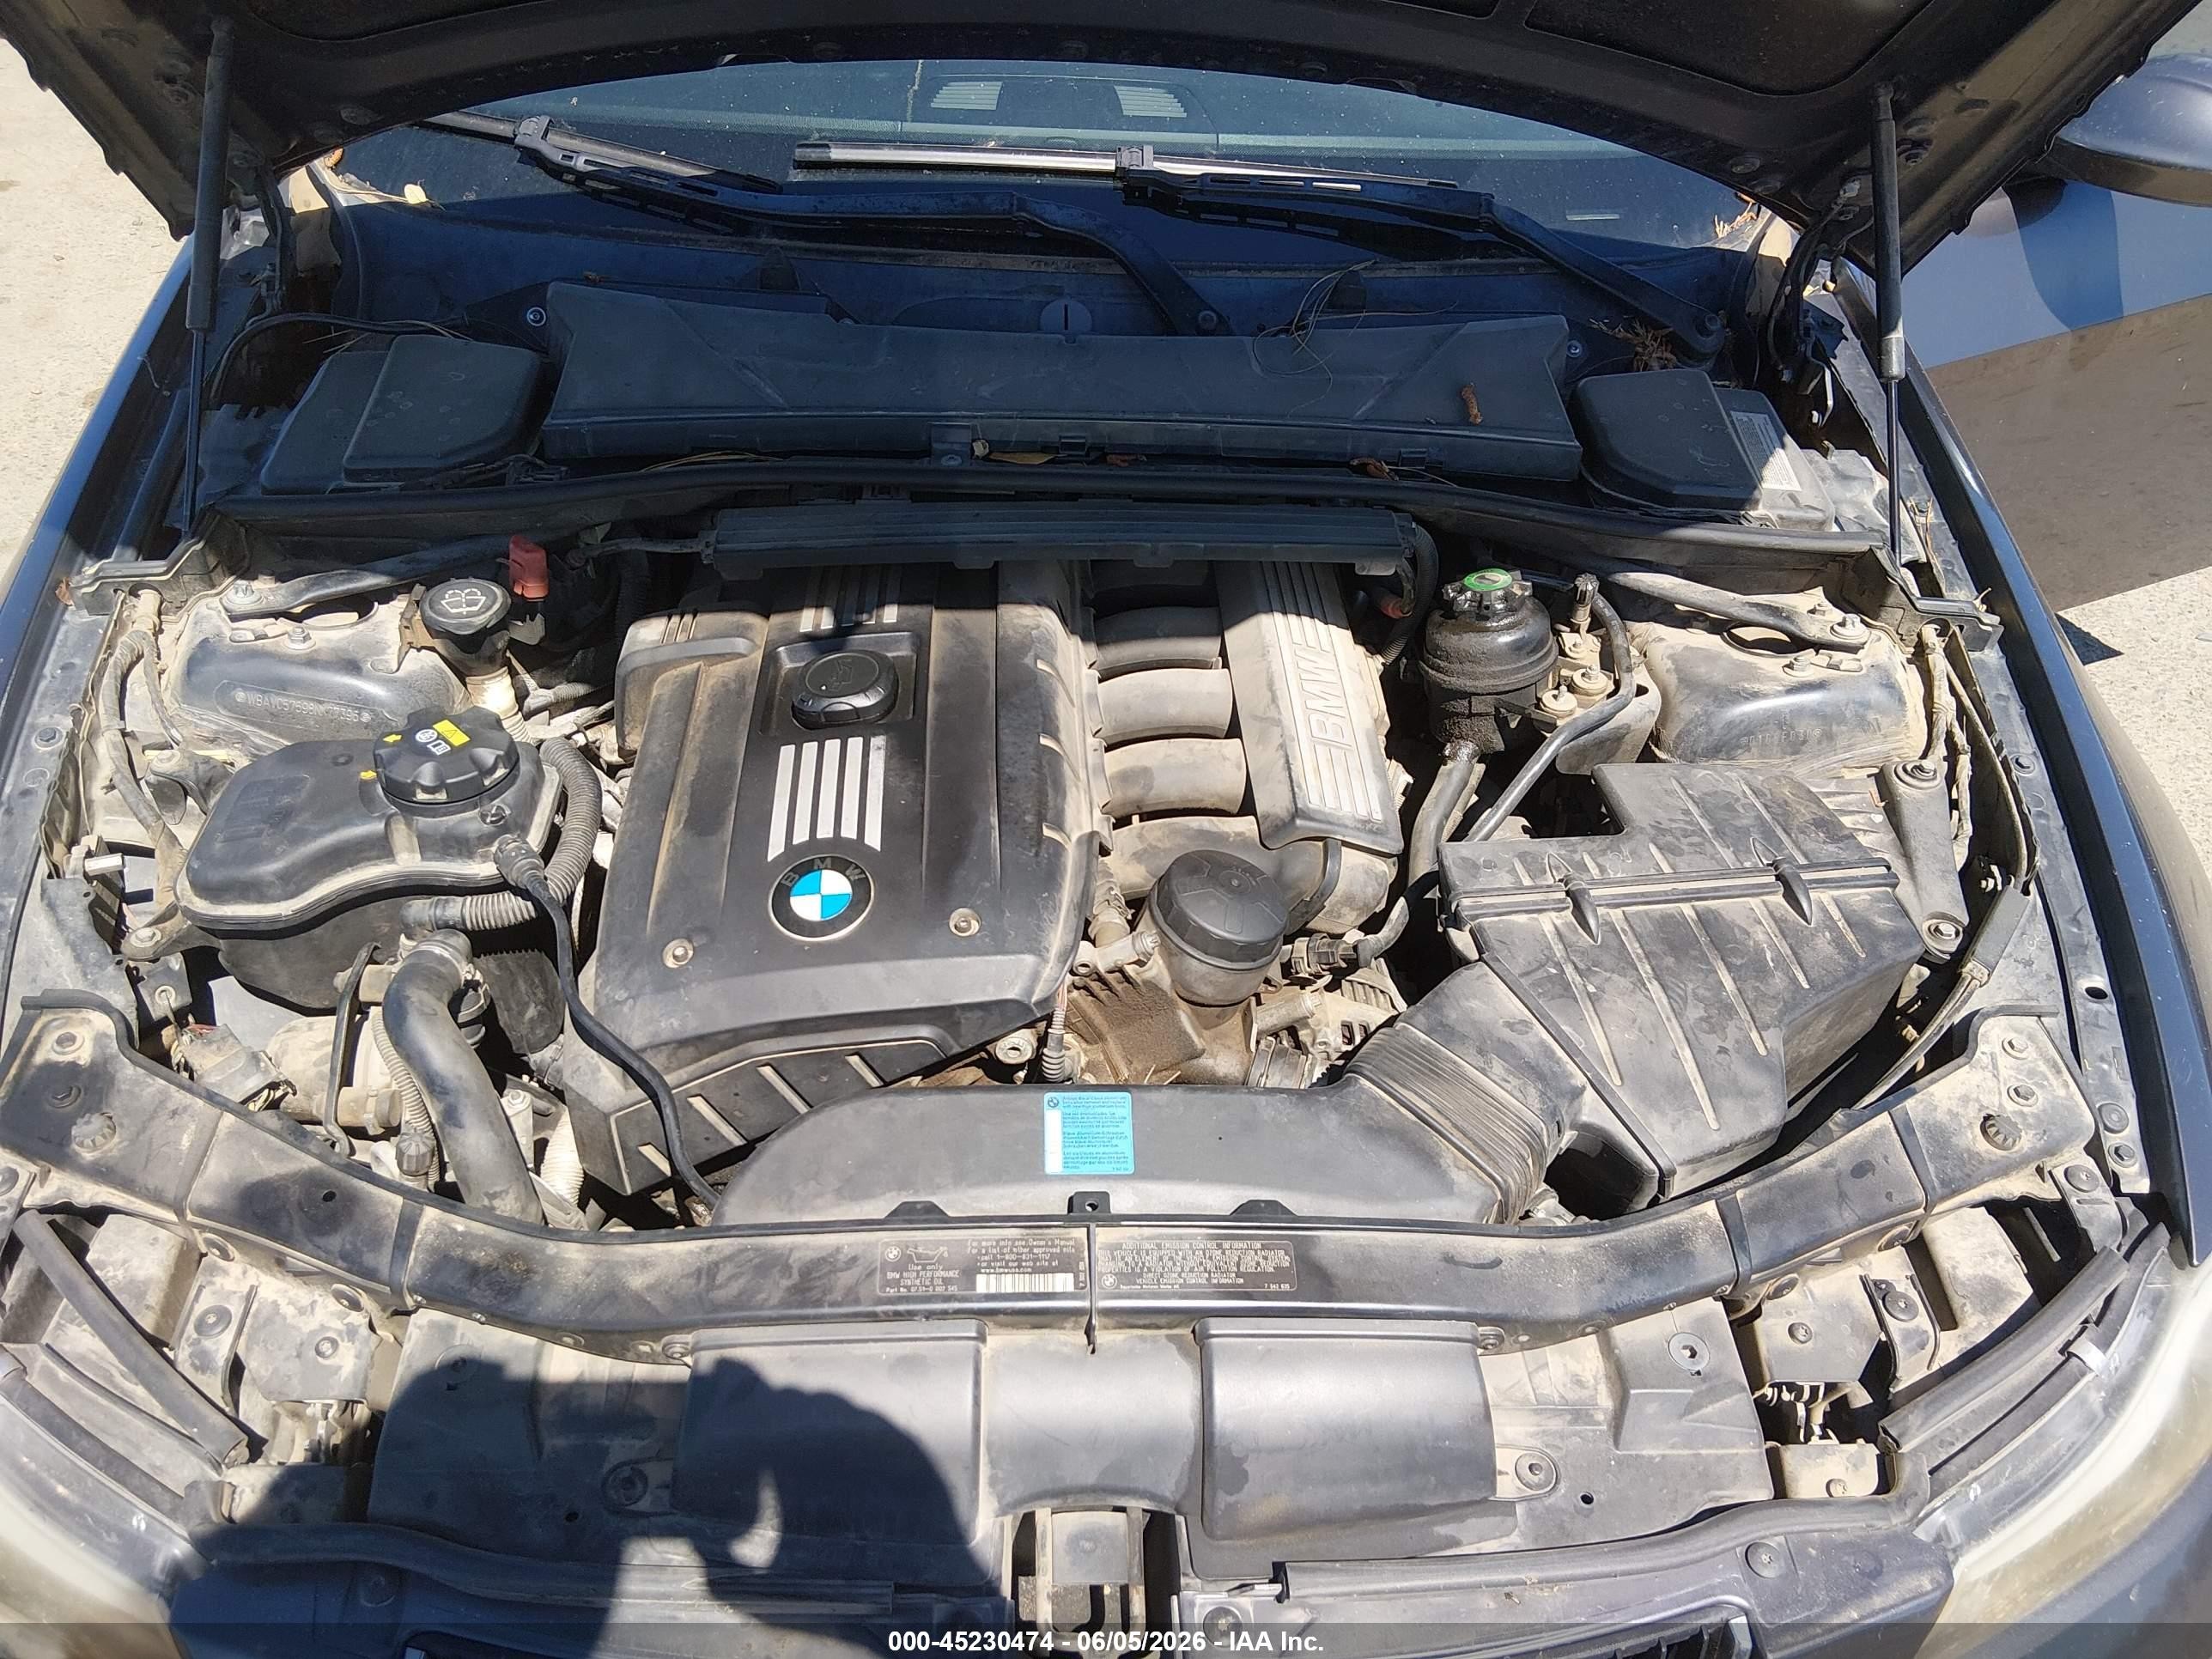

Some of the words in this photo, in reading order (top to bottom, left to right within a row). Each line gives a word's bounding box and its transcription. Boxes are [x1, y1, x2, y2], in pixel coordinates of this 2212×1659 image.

[1293, 647, 1352, 747] BMW
[781, 857, 866, 886] BMW
[1033, 1245, 1060, 1254] approved
[926, 1262, 943, 1272] only
